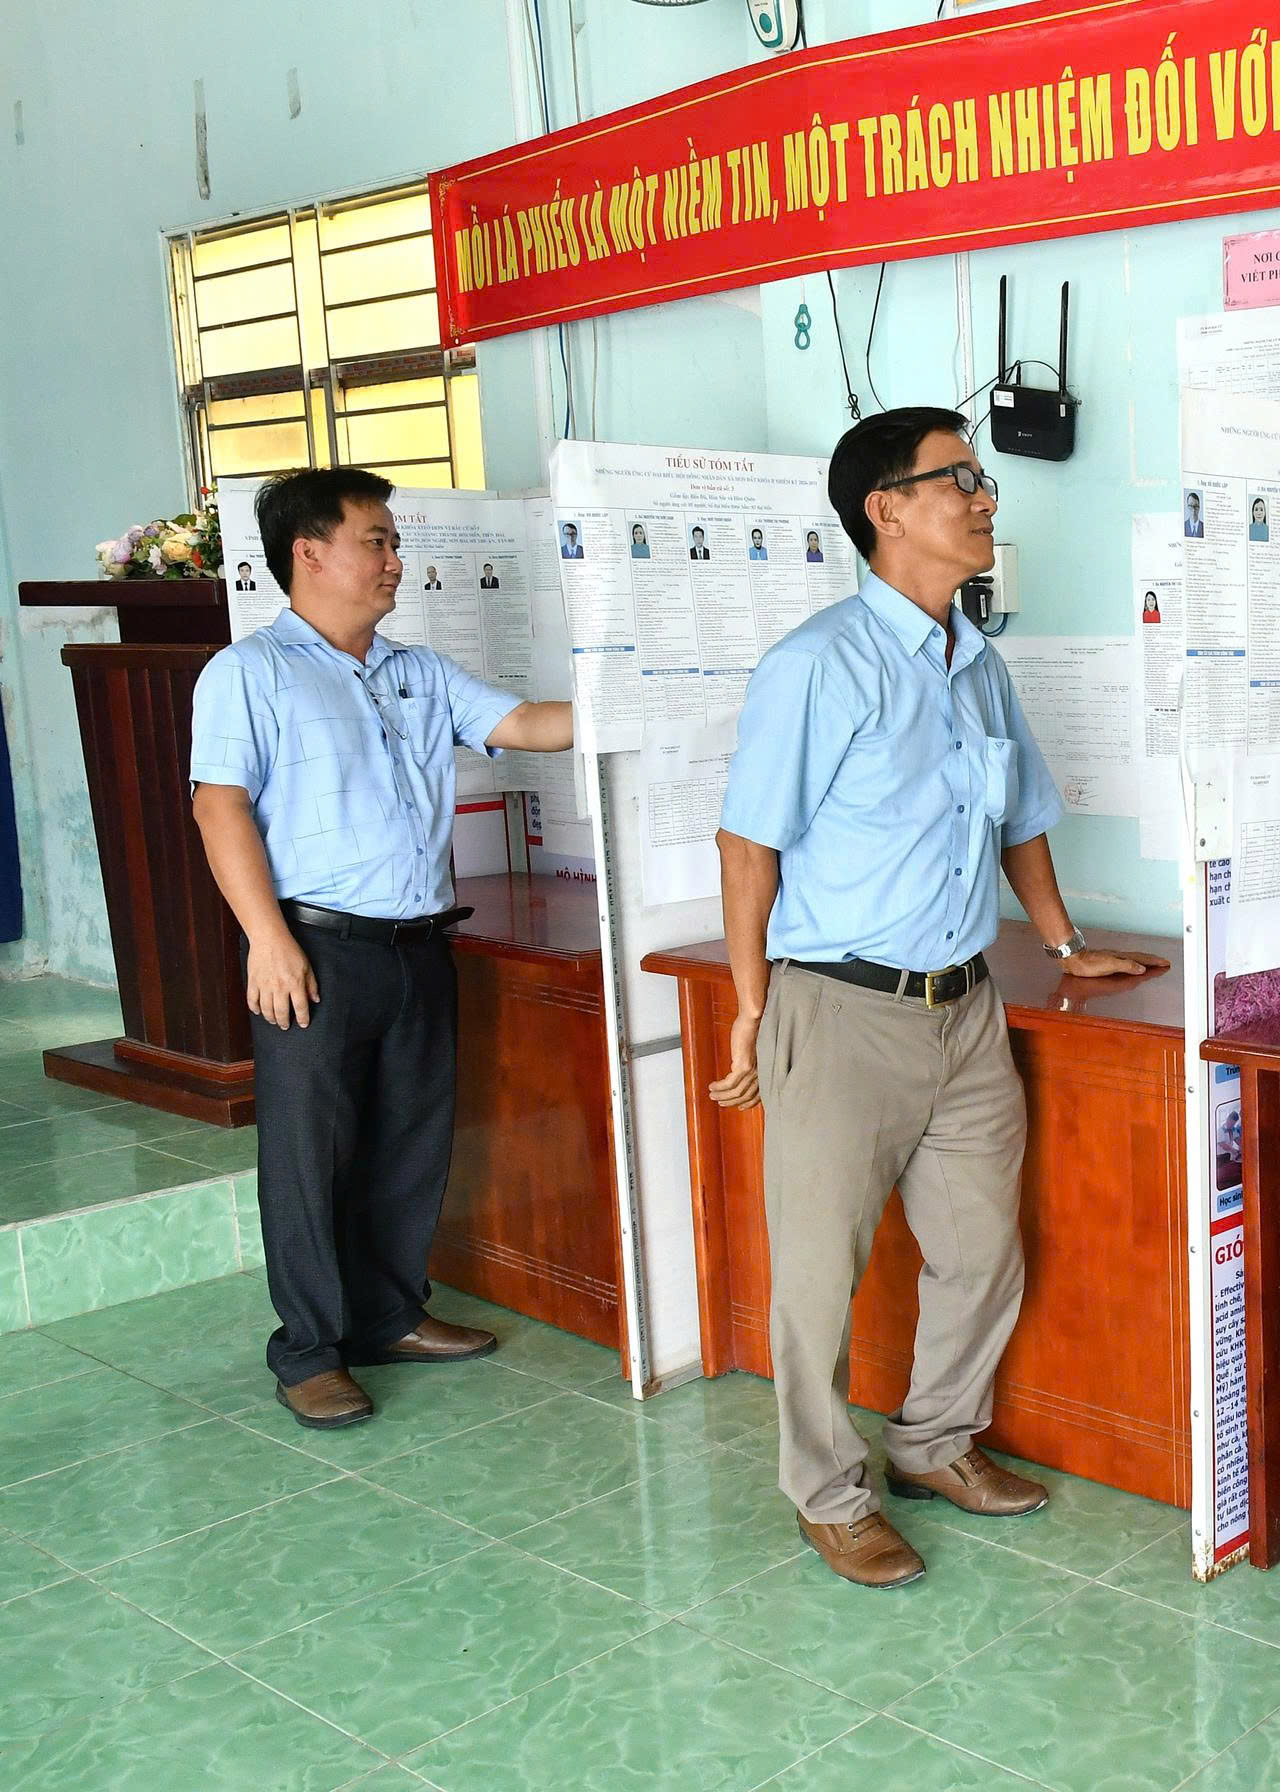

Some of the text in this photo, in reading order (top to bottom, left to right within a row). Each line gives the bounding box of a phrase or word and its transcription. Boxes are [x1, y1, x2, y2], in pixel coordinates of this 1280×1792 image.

[455, 204, 492, 293] MỖI
[495, 203, 518, 283] LÁ
[522, 178, 579, 277] PHIẾU
[580, 179, 608, 261] LÀ
[610, 166, 659, 262] MỘT
[664, 137, 722, 240] NIỀM
[728, 142, 778, 224] TIN,
[784, 113, 848, 221] MỘT
[858, 95, 979, 198] TRÁCH
[989, 66, 1113, 183] NHIỆM
[1124, 32, 1197, 155] ĐỐI
[1254, 253, 1272, 264] NƠI
[1241, 269, 1266, 282] VIẾT
[665, 454, 754, 472] TIỂU SỬ TÓM TẮT
